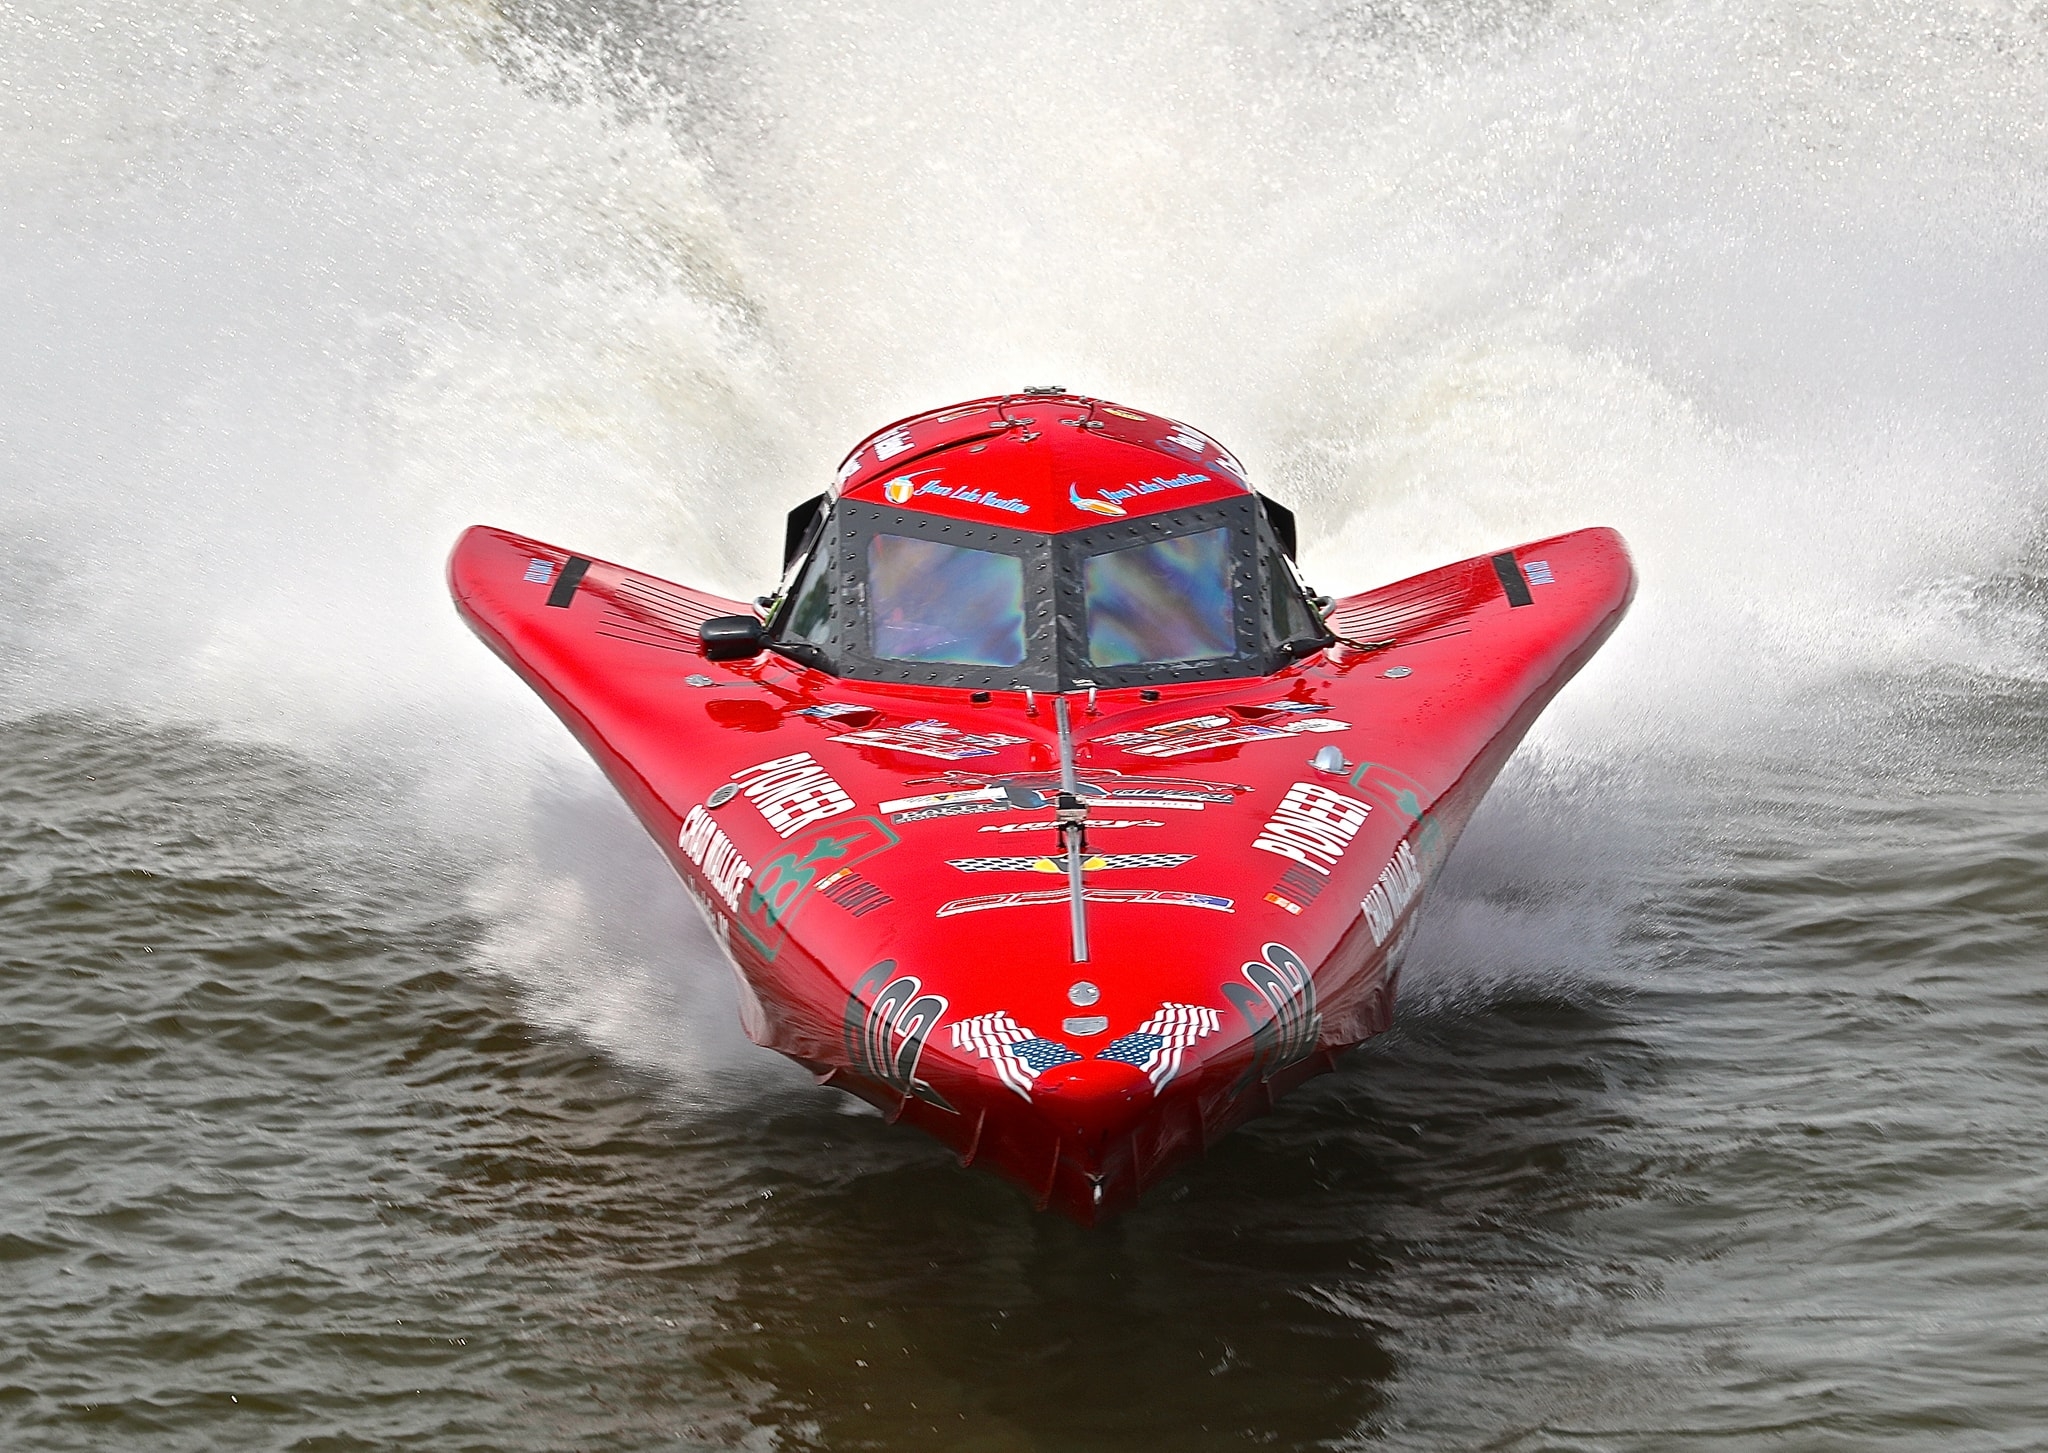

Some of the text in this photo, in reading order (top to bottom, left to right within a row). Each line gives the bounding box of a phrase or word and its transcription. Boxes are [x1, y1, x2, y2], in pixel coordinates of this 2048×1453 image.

[730, 752, 857, 839] PIONEER
[901, 803, 994, 819] BAKER
[1251, 781, 1374, 876] PIONEER
